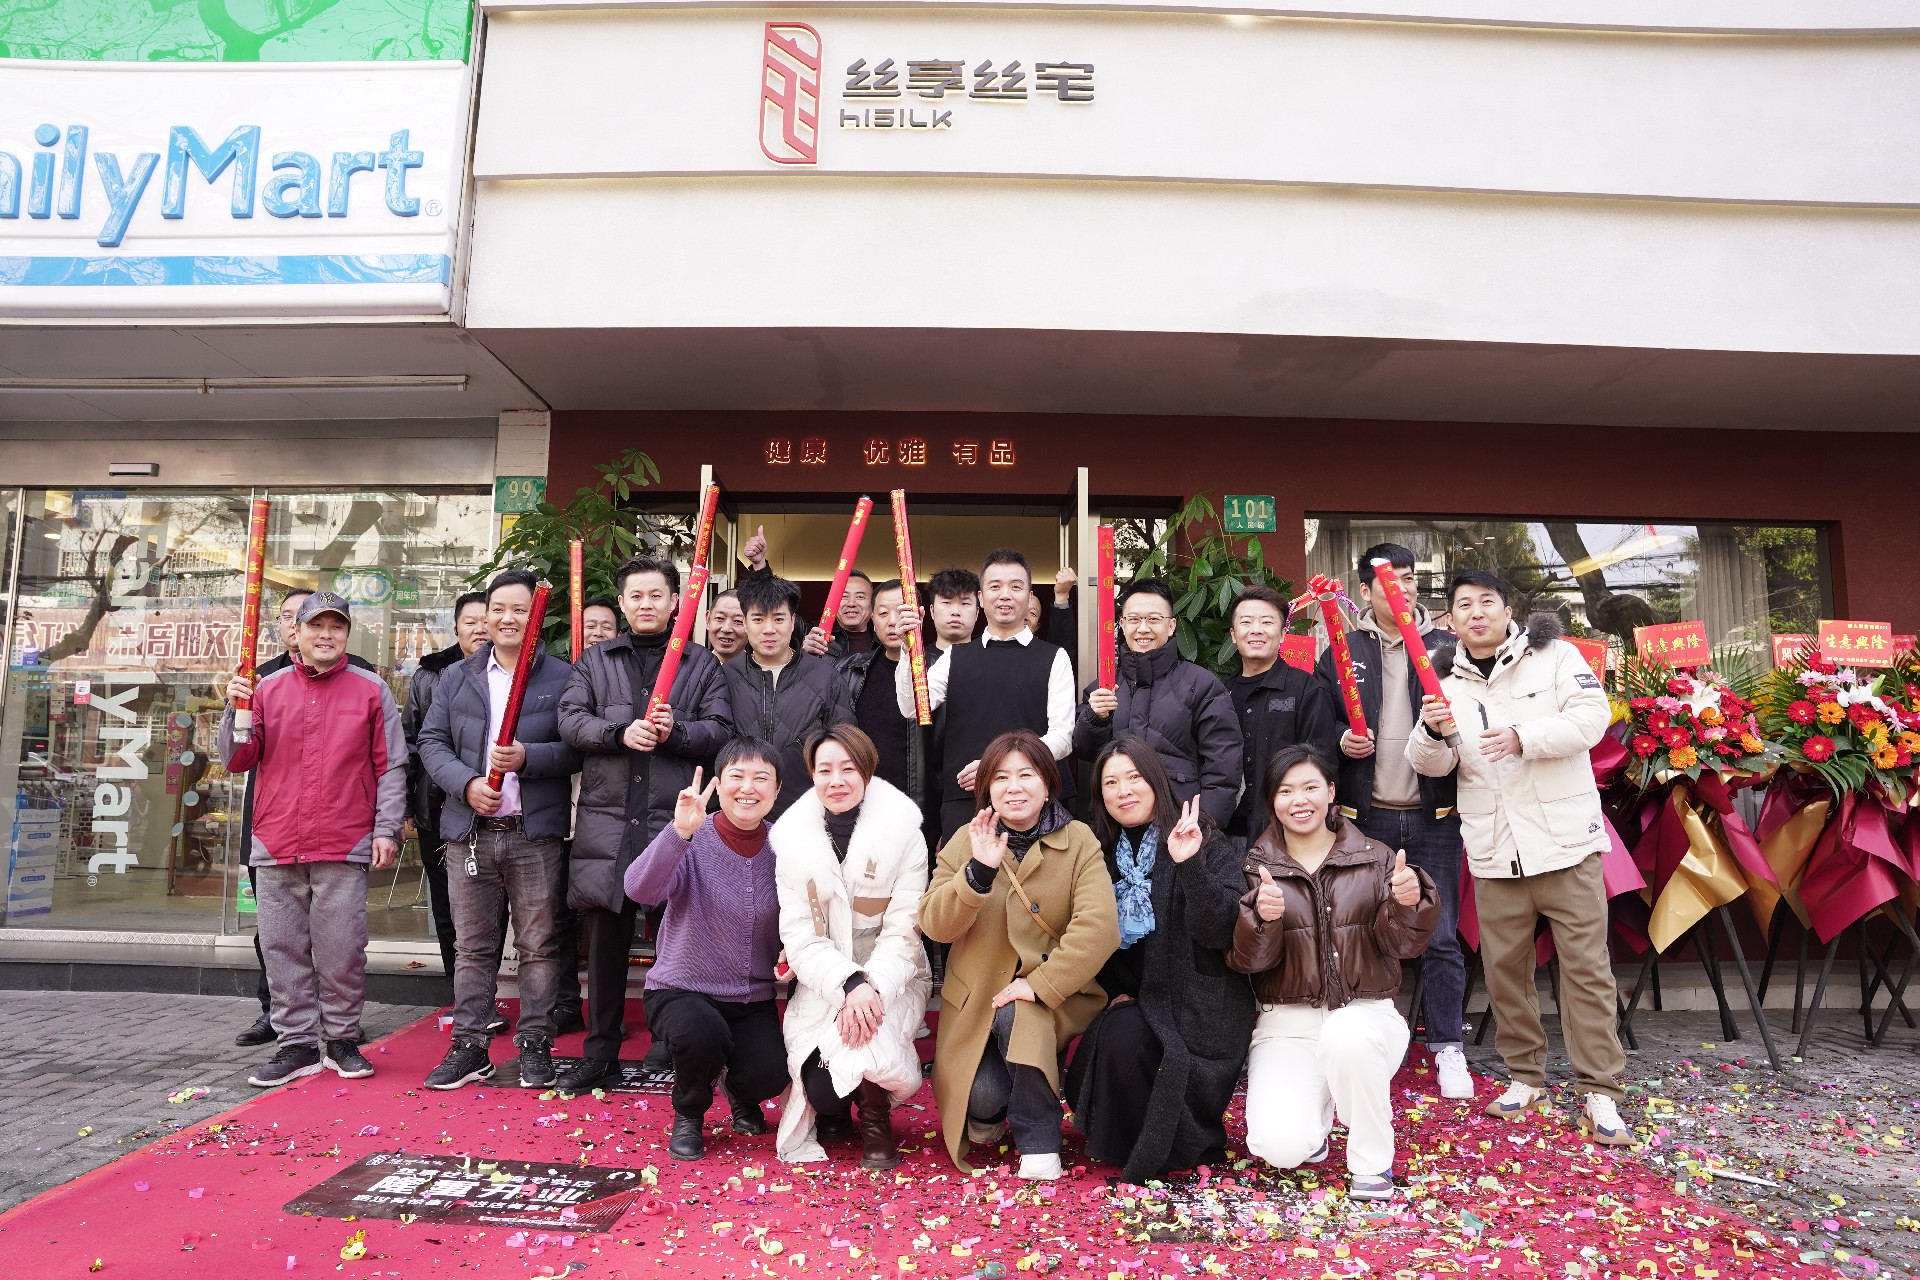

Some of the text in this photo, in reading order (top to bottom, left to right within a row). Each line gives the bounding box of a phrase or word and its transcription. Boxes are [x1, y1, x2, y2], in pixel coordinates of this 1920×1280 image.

[843, 58, 1094, 101] 丝享丝宅
[765, 439, 1015, 465] 健康 优雅 有品
[508, 480, 532, 499] 99
[1231, 498, 1268, 519] 101
[1825, 633, 1888, 651] 生意興隆
